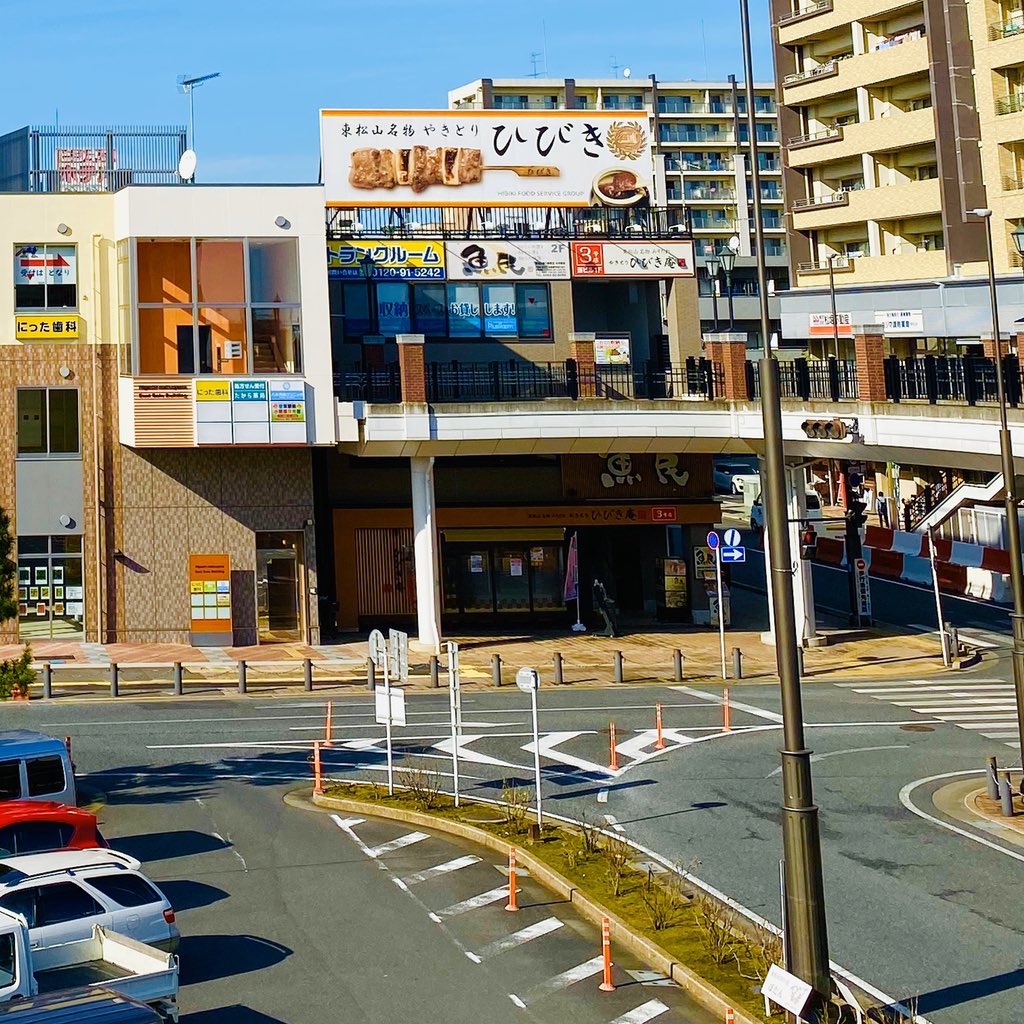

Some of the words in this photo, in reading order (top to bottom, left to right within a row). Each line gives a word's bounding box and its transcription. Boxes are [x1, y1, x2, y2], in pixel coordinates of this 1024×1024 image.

[341, 123, 415, 137] 東松山名物
[423, 123, 480, 137] やきとり
[491, 123, 605, 159] ひびき
[327, 245, 440, 265] トランクルーム
[551, 243, 565, 253] 2F
[17, 321, 77, 333] にった歯科
